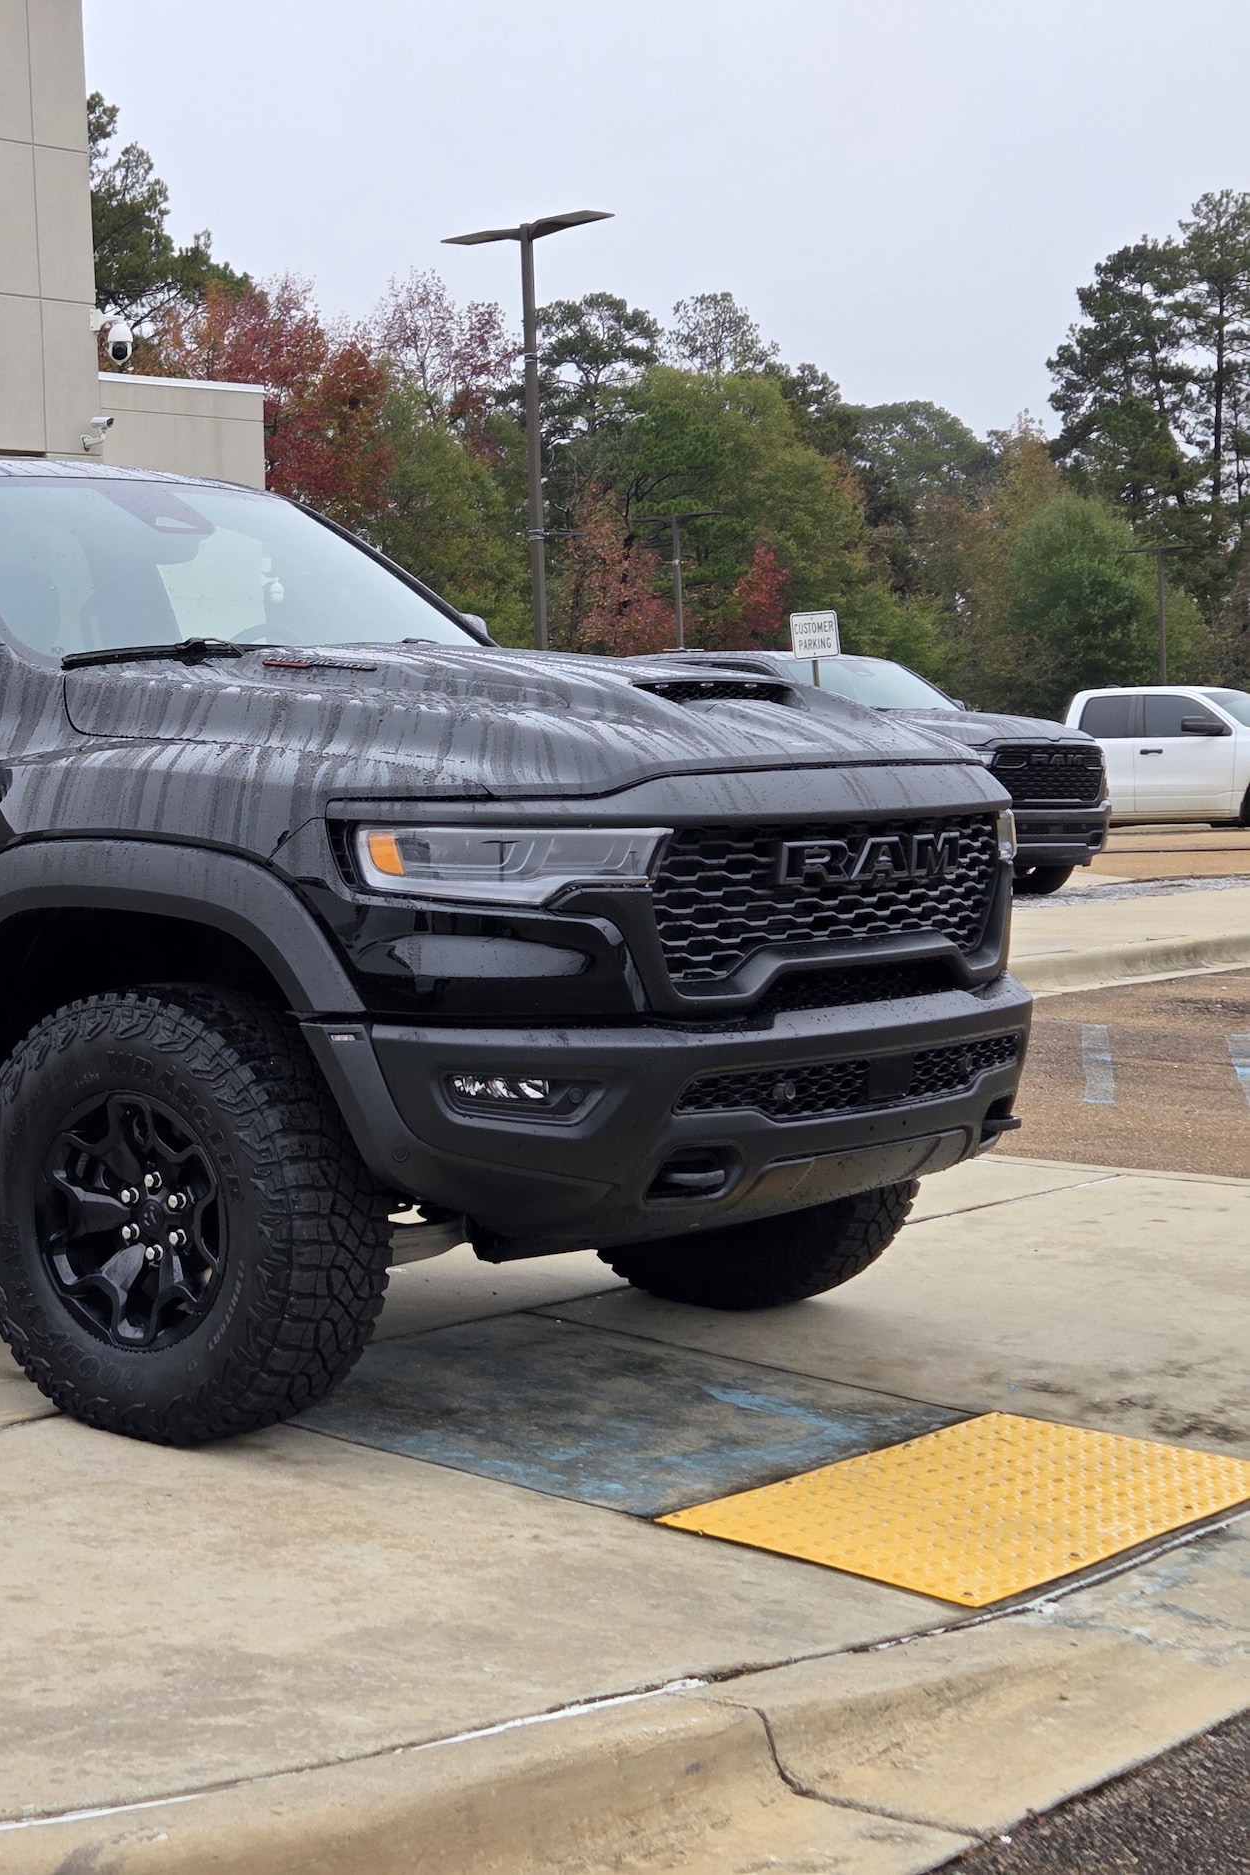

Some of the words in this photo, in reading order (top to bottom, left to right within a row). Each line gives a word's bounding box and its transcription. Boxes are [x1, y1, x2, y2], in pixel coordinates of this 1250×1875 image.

[794, 620, 834, 635] CUSTOMER
[798, 637, 832, 650] PARKING
[1030, 753, 1085, 767] RAM
[780, 832, 961, 884] RAM
[106, 1051, 244, 1202] WRANGLER
[0, 1221, 143, 1391] GOODYEAR
